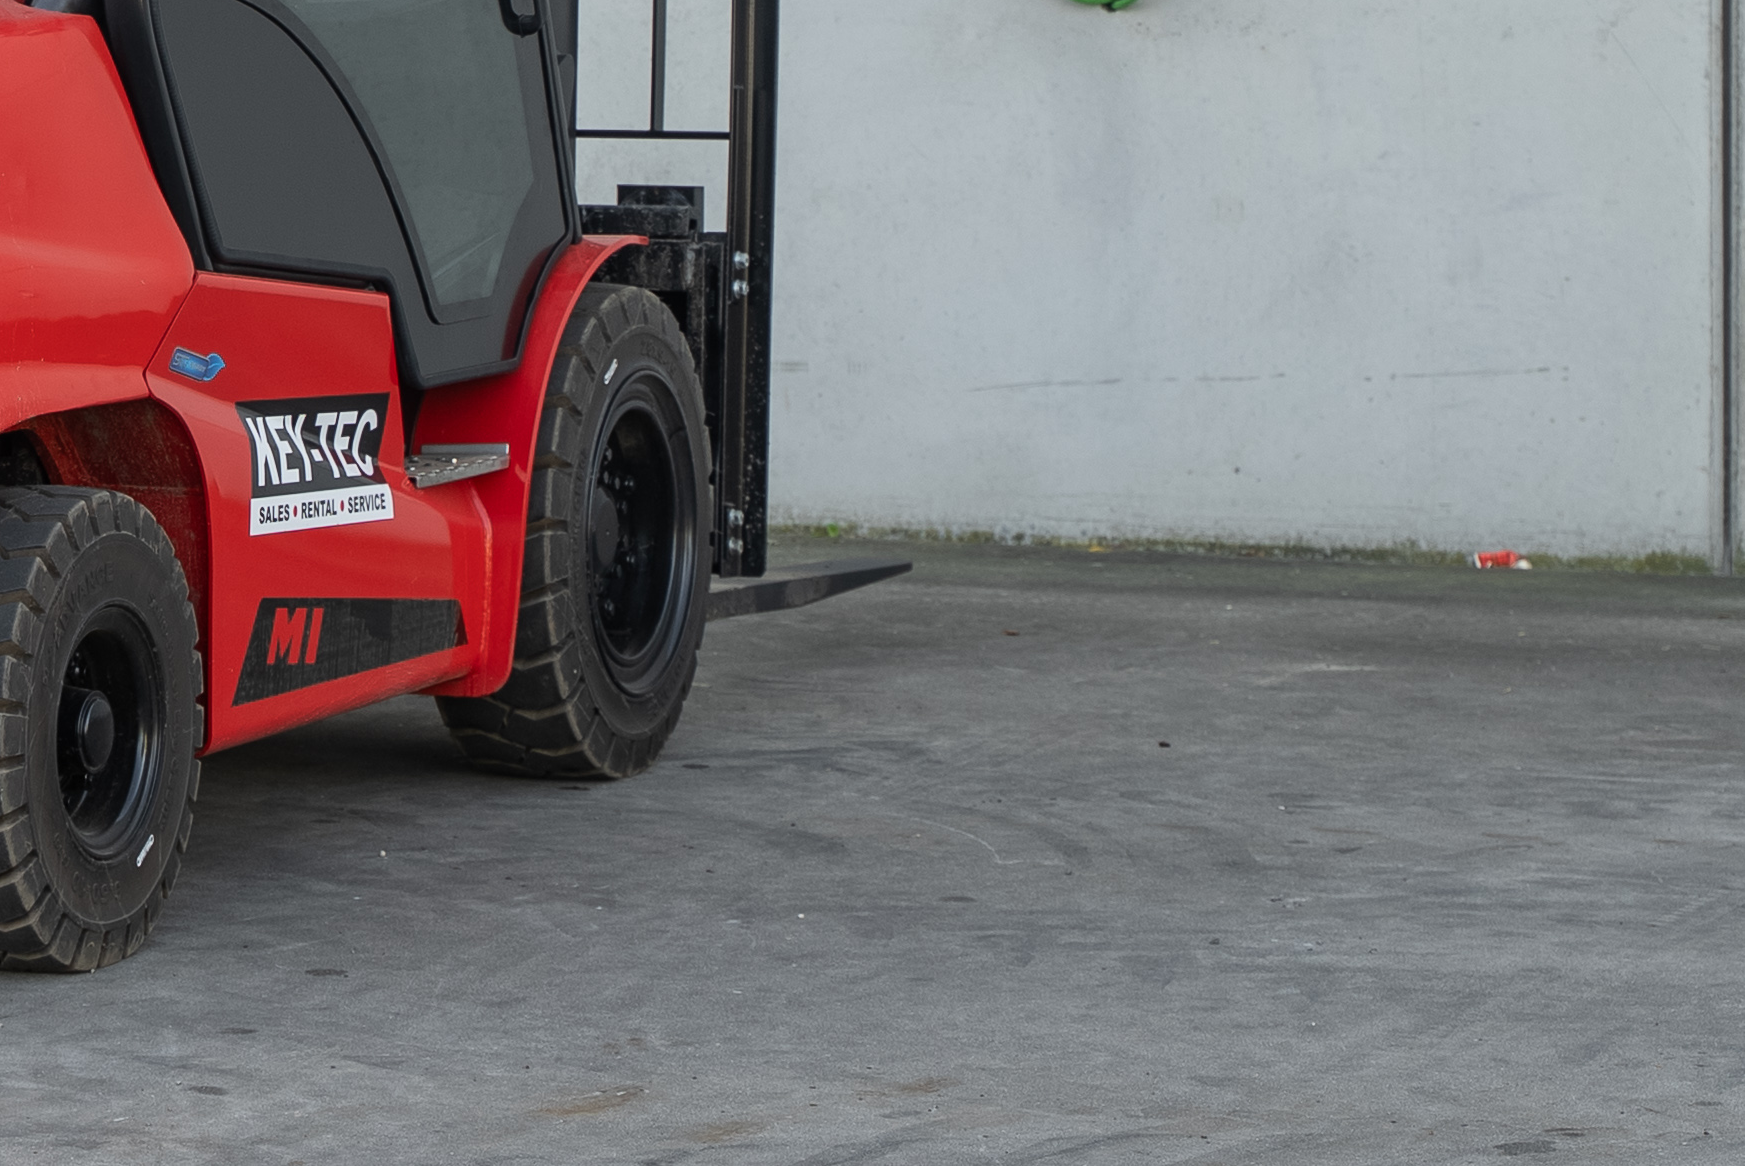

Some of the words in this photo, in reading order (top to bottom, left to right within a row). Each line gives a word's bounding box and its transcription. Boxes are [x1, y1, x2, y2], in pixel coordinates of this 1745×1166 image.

[245, 409, 378, 486] KEY-TEC
[259, 503, 290, 524] SALES
[301, 499, 337, 519] RENTAL
[347, 493, 386, 514] SERVICE
[267, 608, 324, 664] MI
